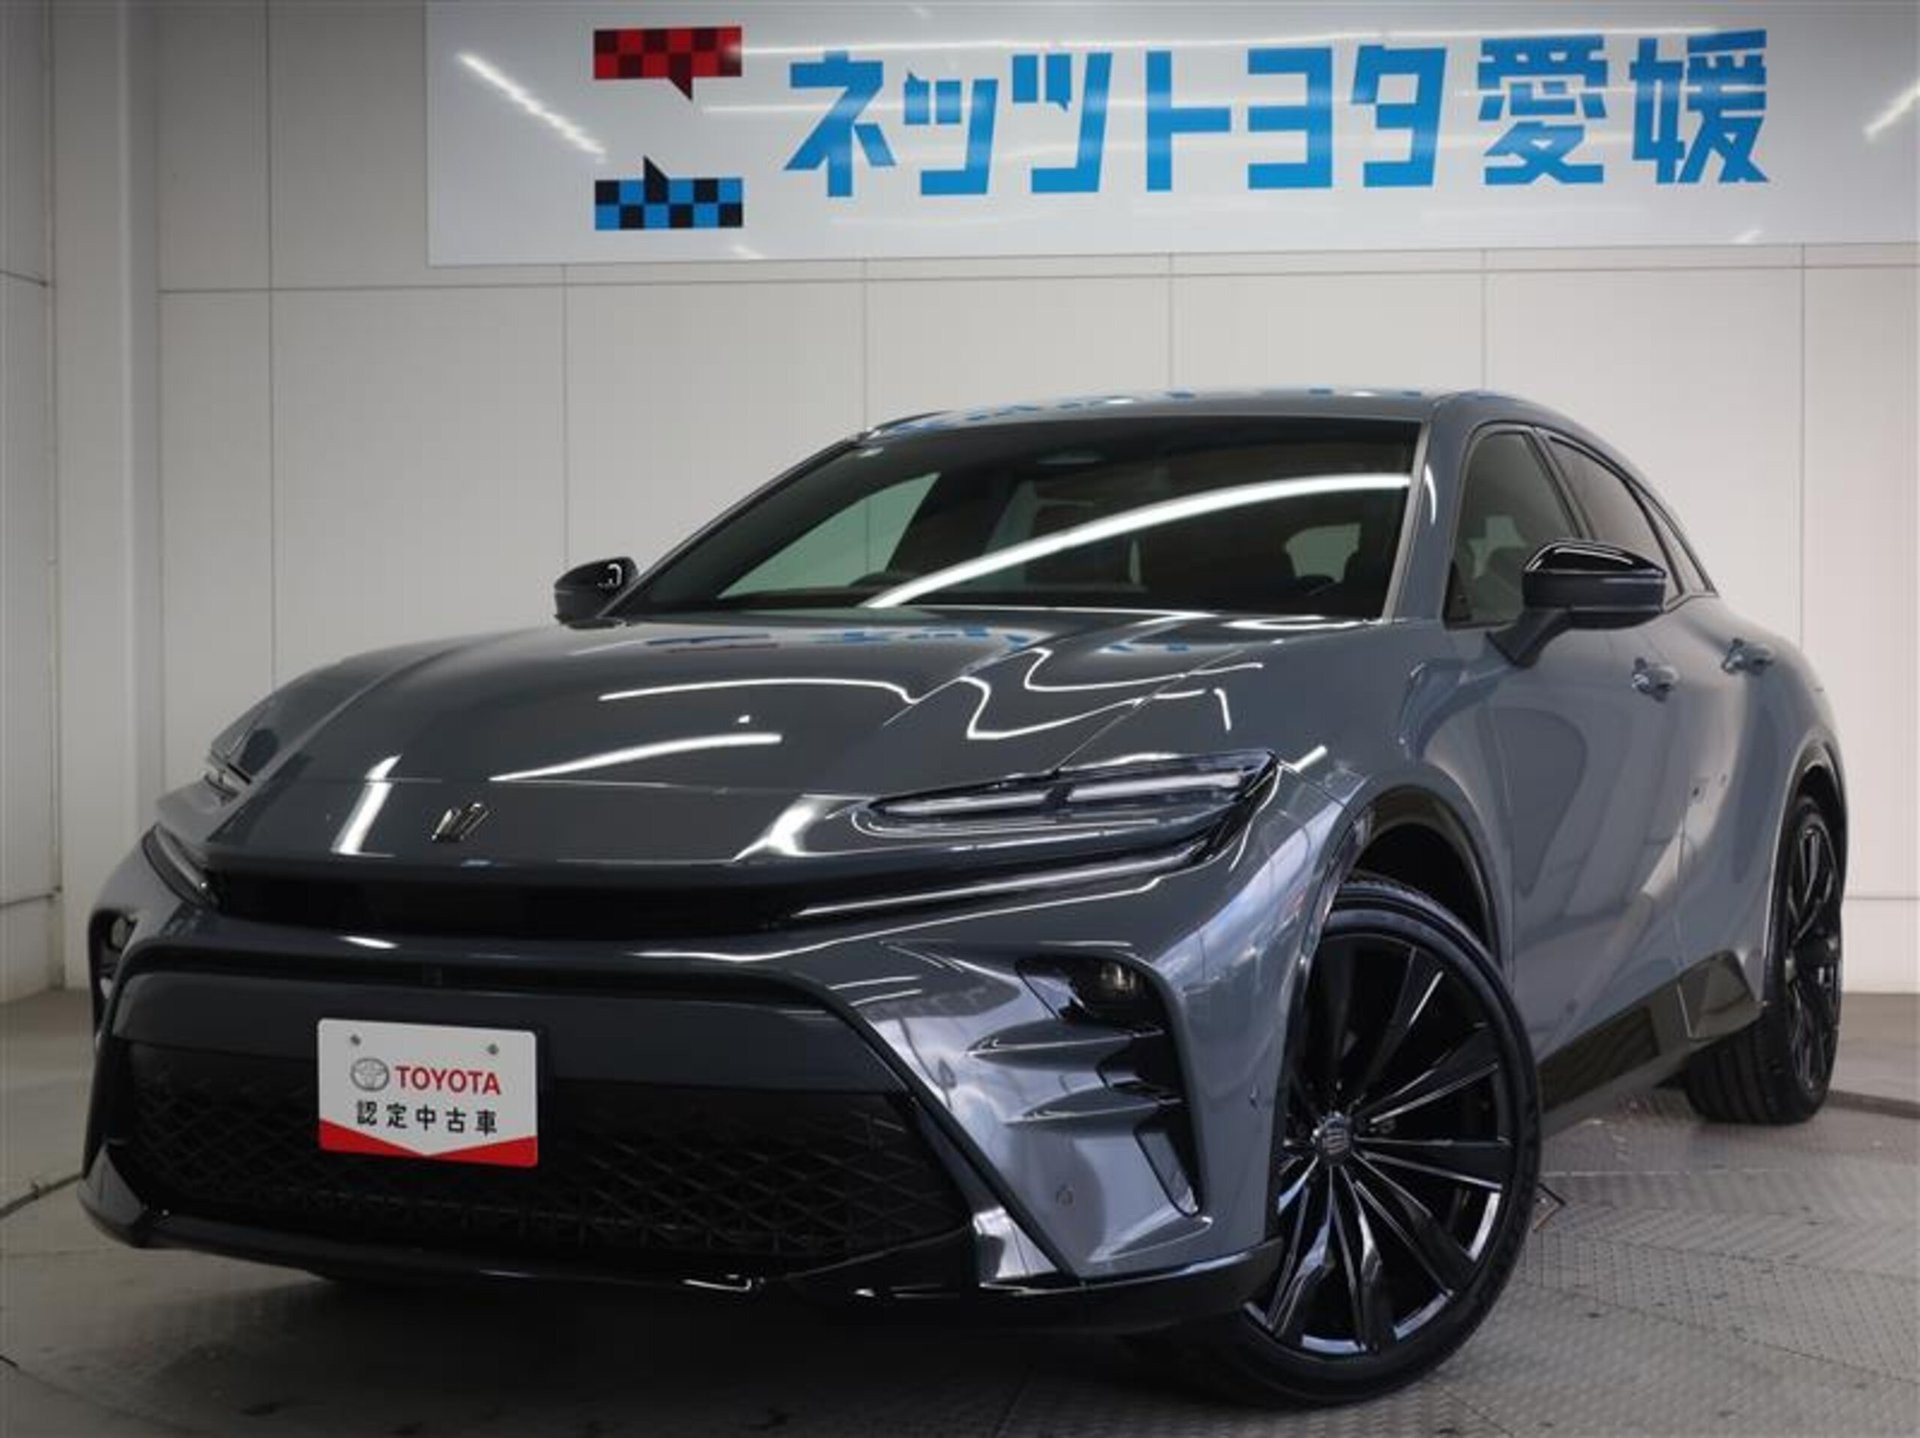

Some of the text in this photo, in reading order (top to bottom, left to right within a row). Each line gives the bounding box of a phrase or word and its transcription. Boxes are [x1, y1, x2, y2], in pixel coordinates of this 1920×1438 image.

[783, 28, 1769, 197] ネッツトヨタ愛媛
[396, 1066, 502, 1095] TOYOTA
[356, 1101, 498, 1136] 認定中古車
